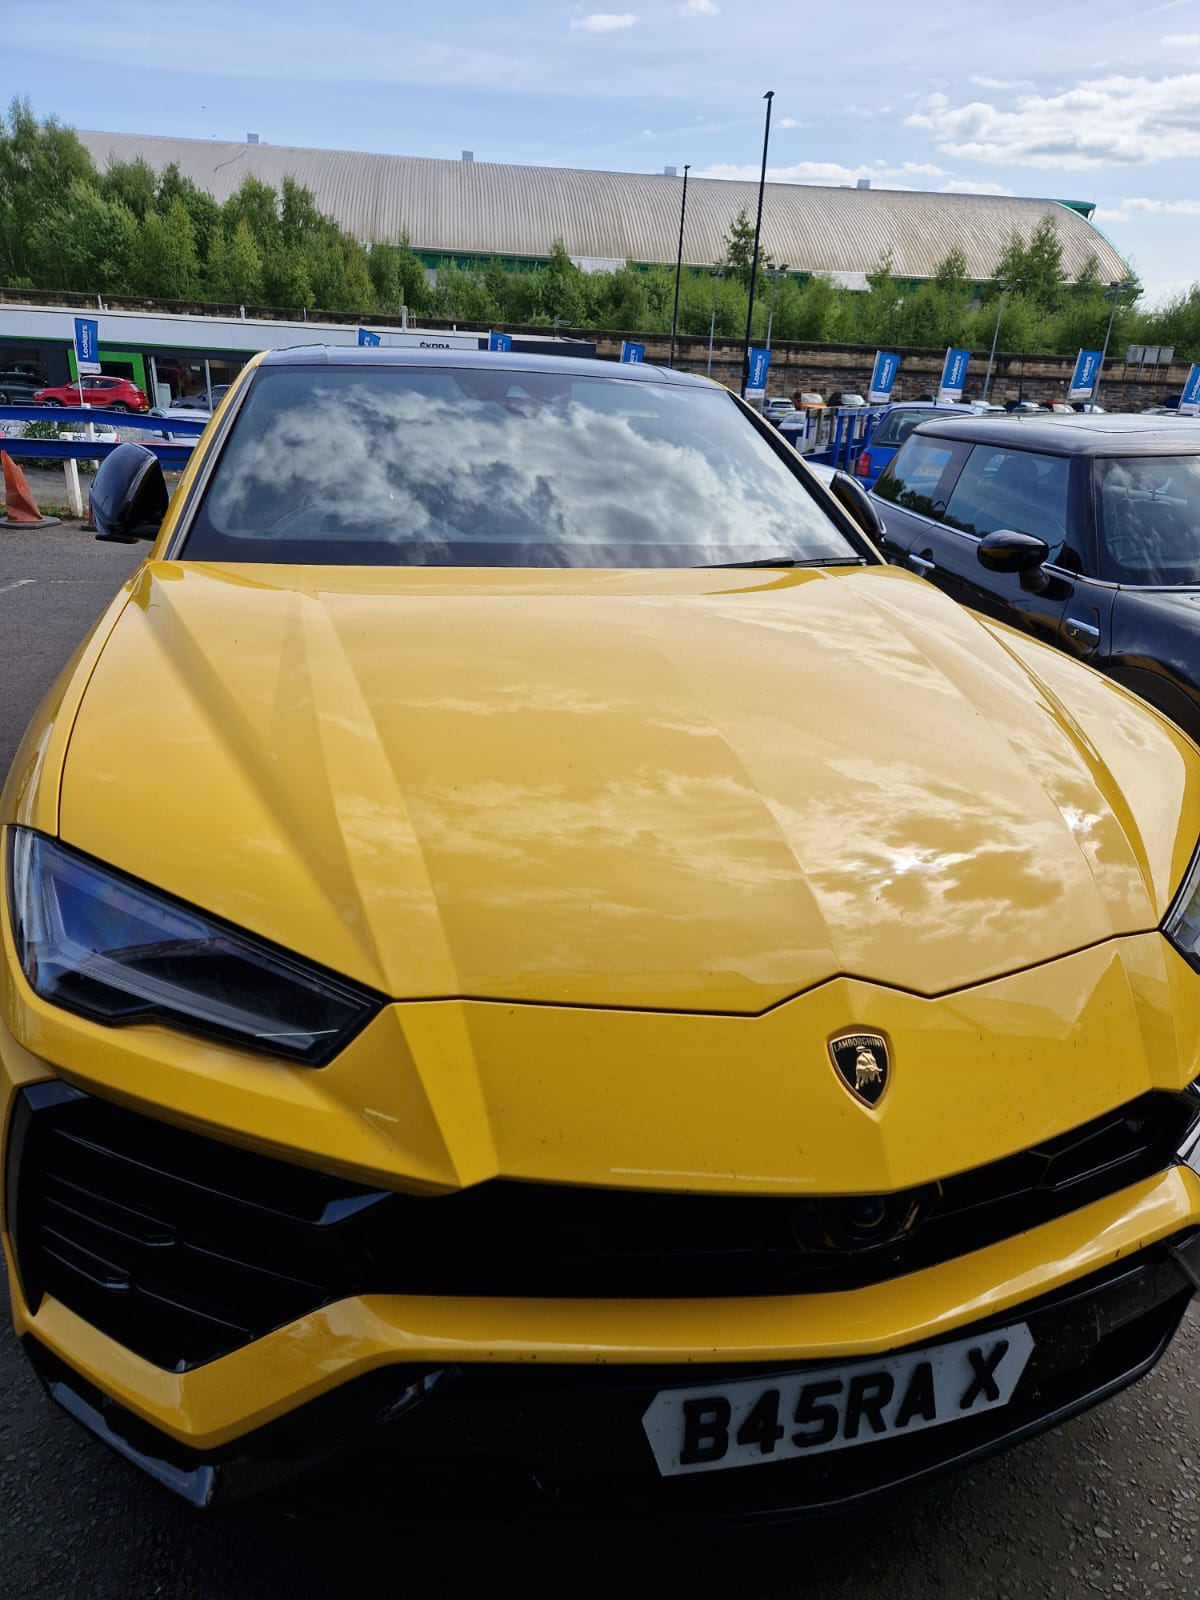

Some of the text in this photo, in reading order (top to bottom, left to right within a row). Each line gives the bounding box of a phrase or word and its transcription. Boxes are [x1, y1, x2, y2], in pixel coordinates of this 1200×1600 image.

[752, 354, 763, 385] Lookers
[878, 358, 891, 389] Lookers
[949, 355, 962, 385] Lookers
[833, 1037, 883, 1052] LAMBORGHINI
[680, 1340, 1009, 1465] B45RA X
